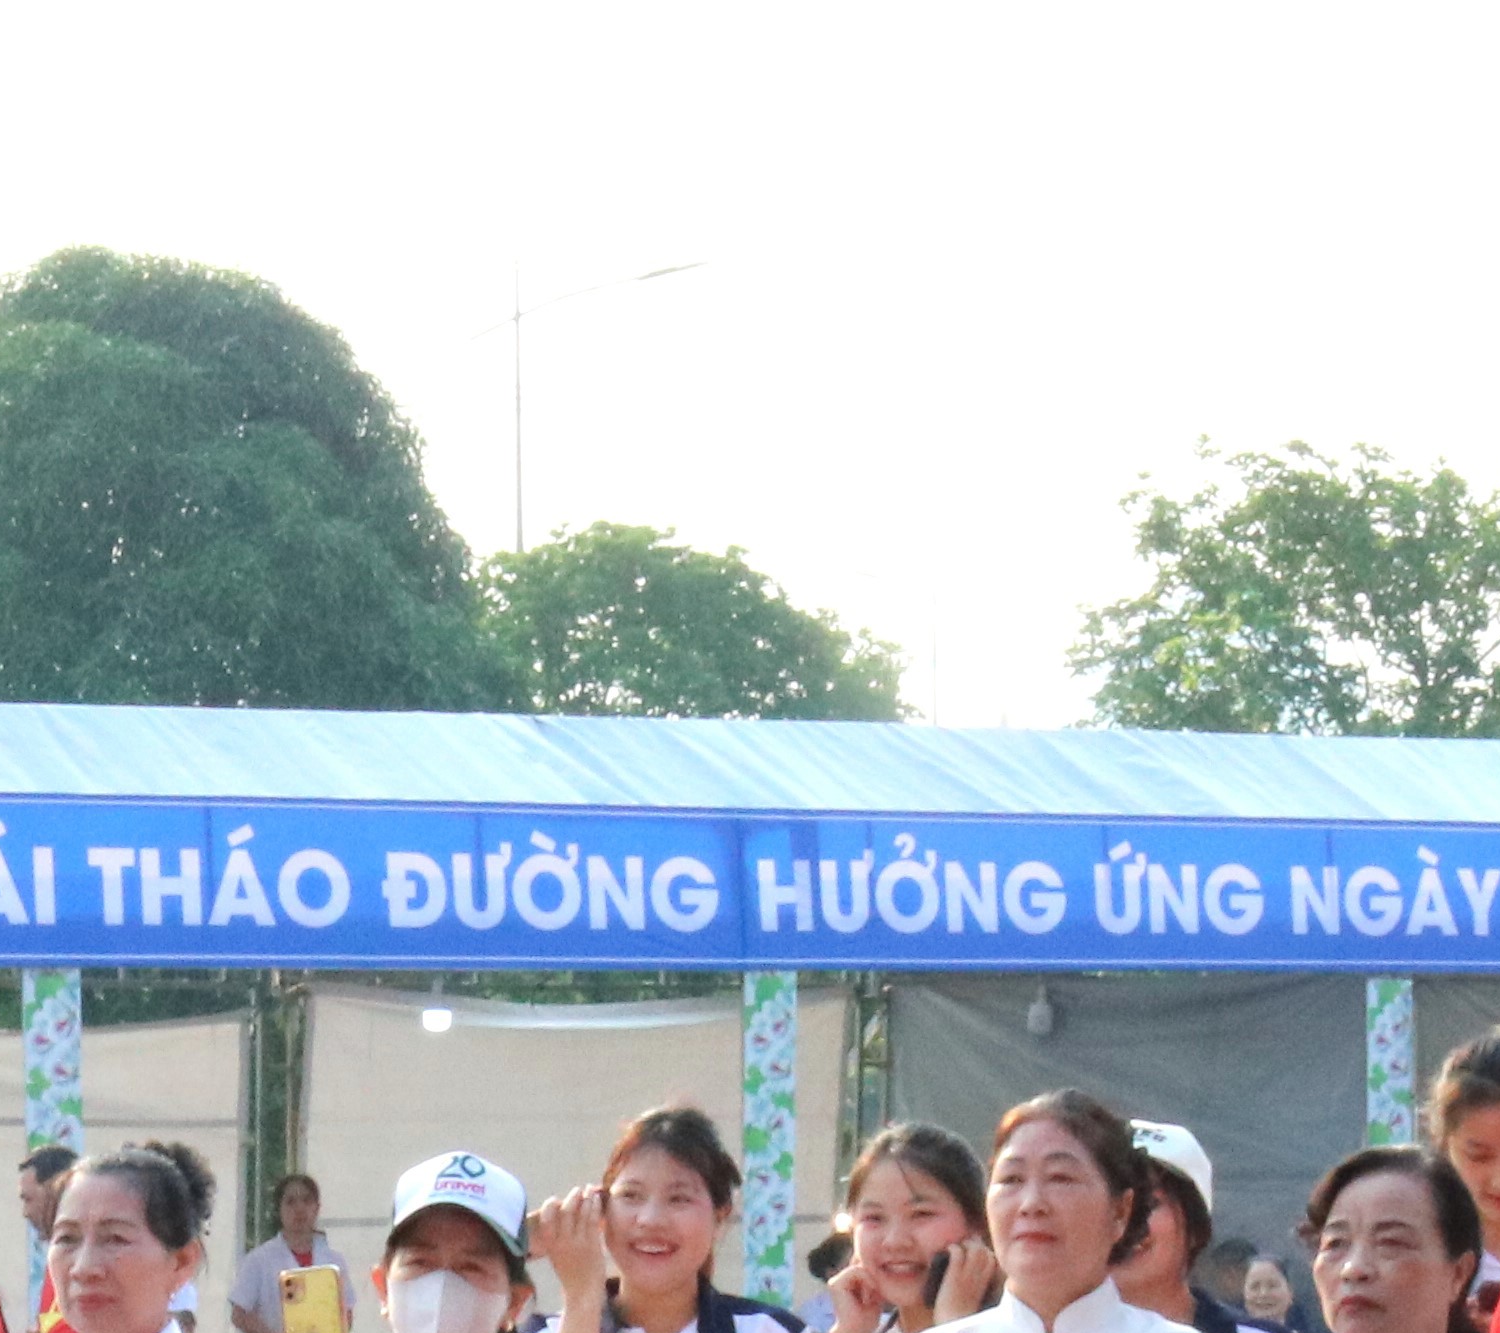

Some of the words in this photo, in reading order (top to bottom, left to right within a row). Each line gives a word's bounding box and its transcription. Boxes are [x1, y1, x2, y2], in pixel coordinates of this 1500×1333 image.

[86, 823, 351, 928] THÁO
[381, 830, 719, 932] ĐƯỜNG
[756, 832, 1067, 934] HƯỞNG
[1093, 840, 1264, 935] ỨNG
